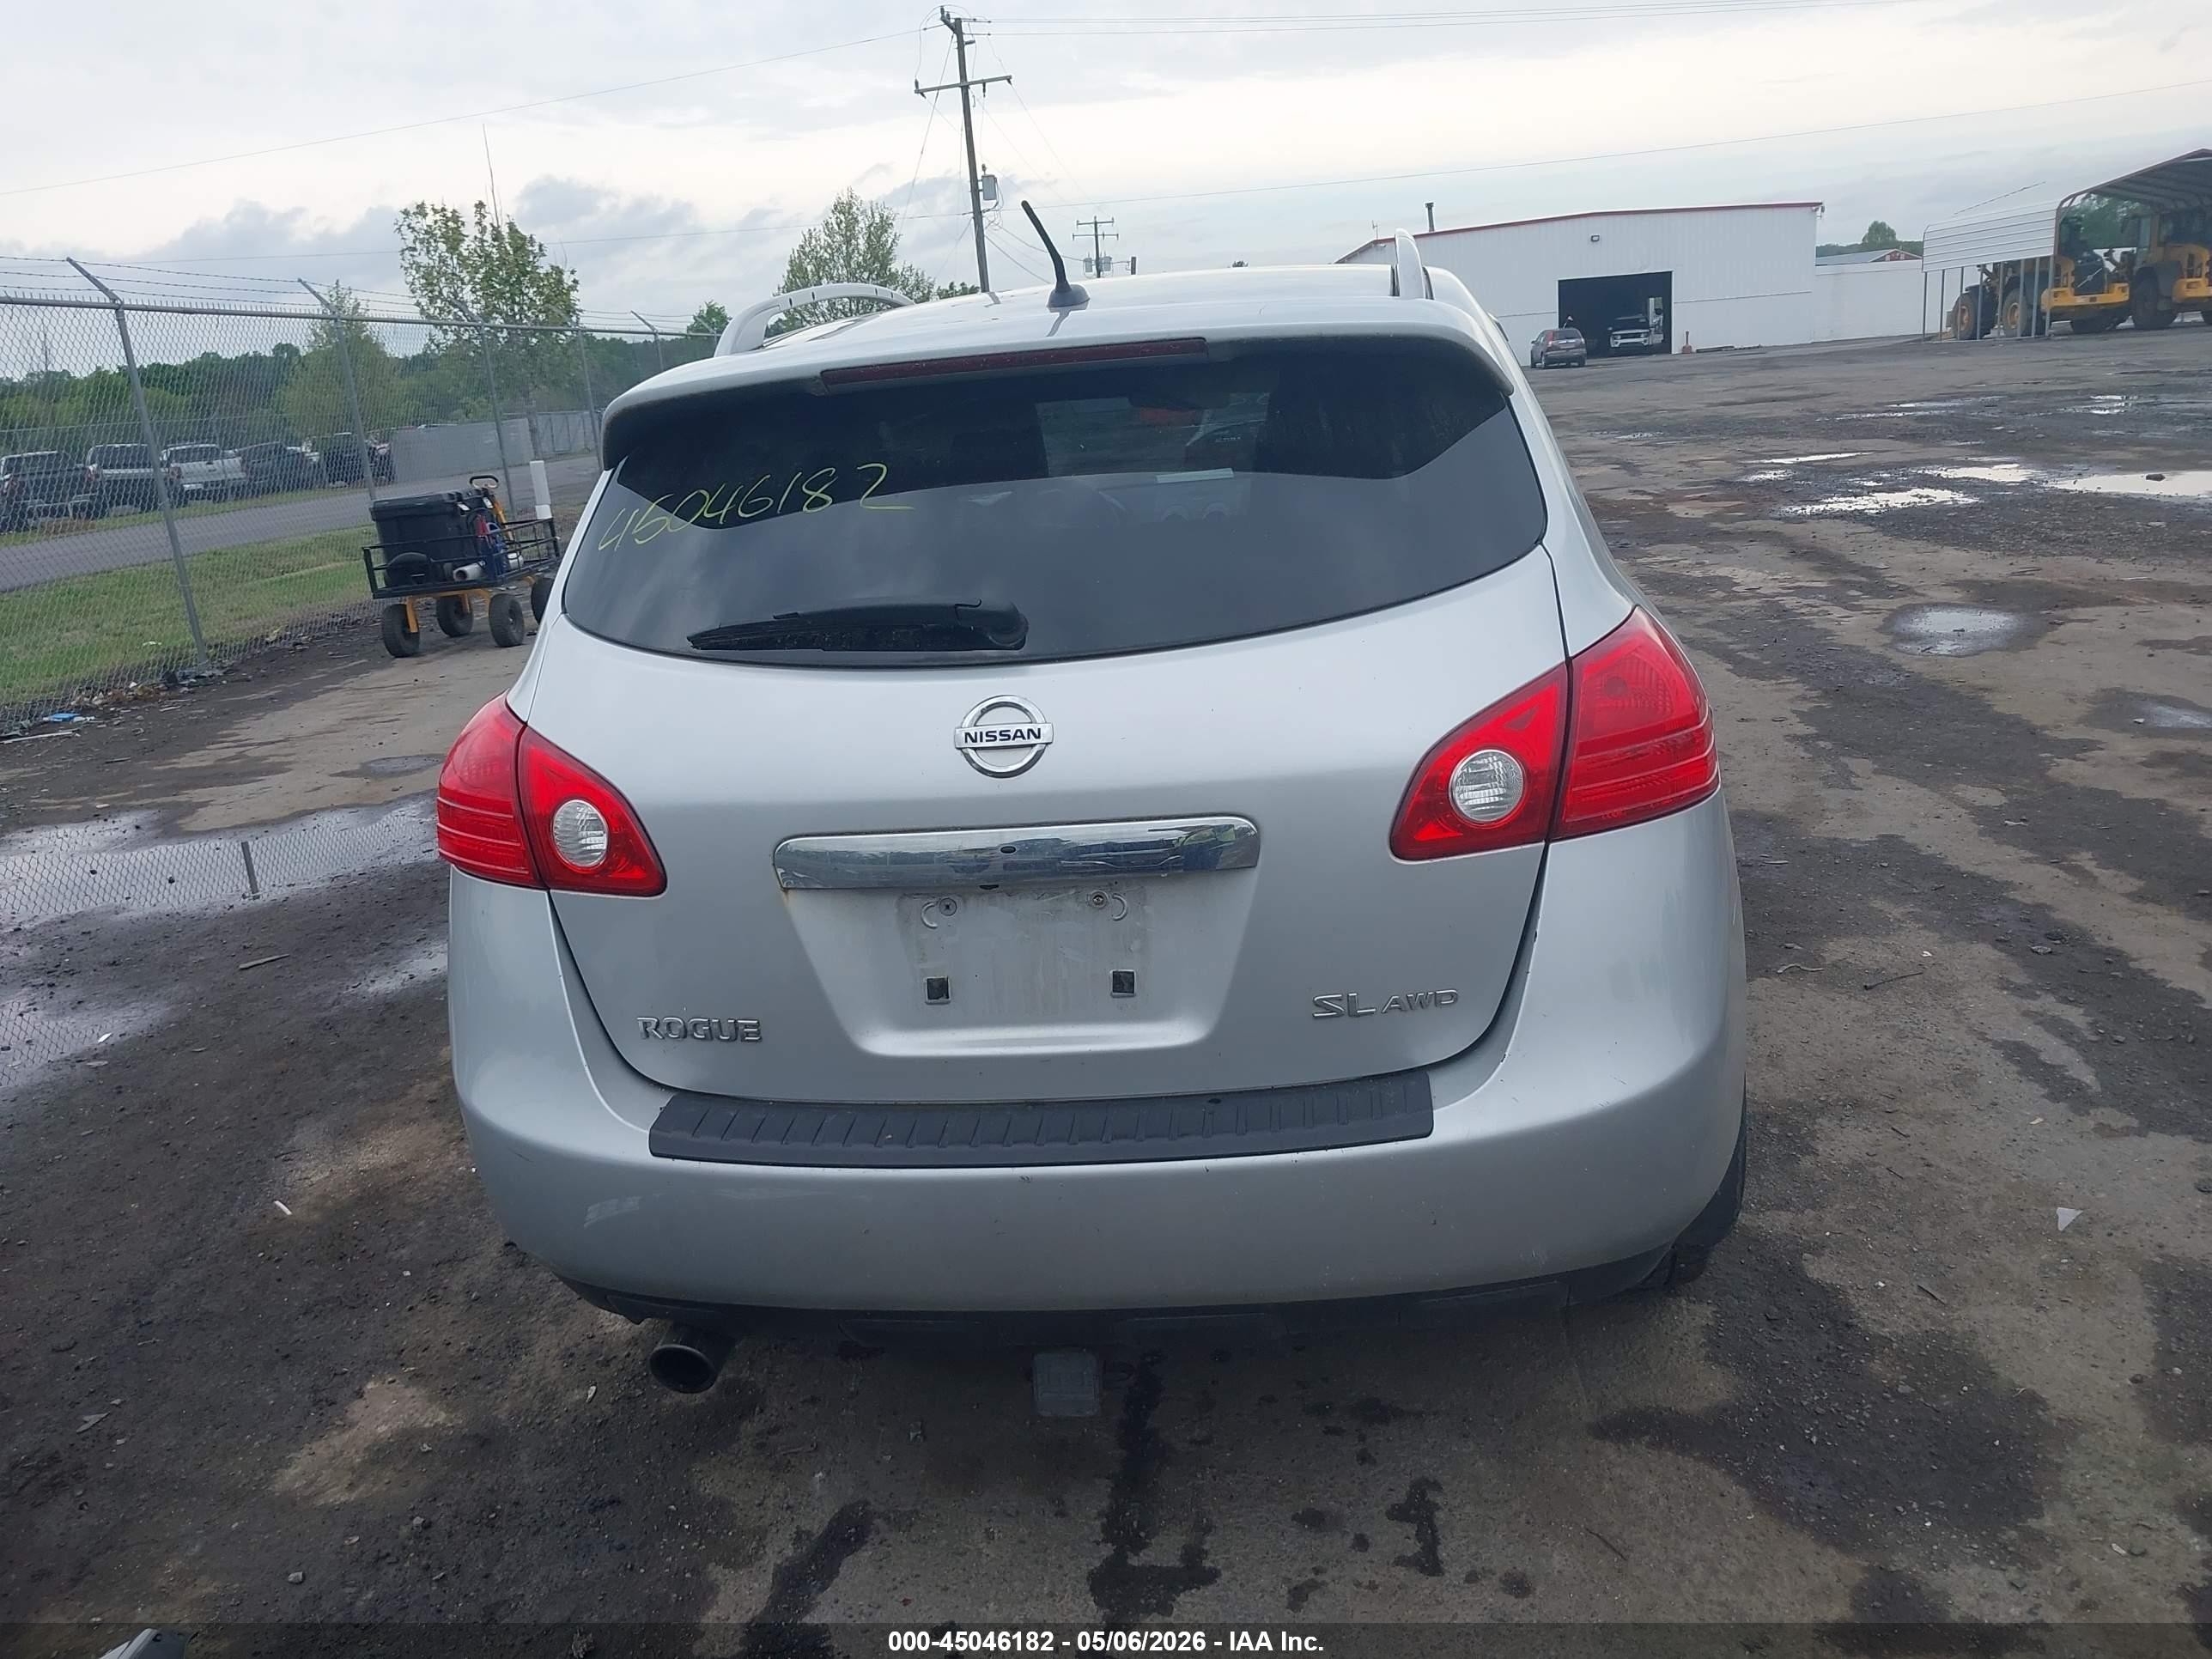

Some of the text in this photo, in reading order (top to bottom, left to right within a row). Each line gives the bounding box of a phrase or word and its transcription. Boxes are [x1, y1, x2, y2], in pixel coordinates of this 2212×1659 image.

[963, 727, 1042, 744] NISSAN
[1312, 988, 1459, 1018] SL AWD
[636, 1016, 763, 1042] ROGUE
